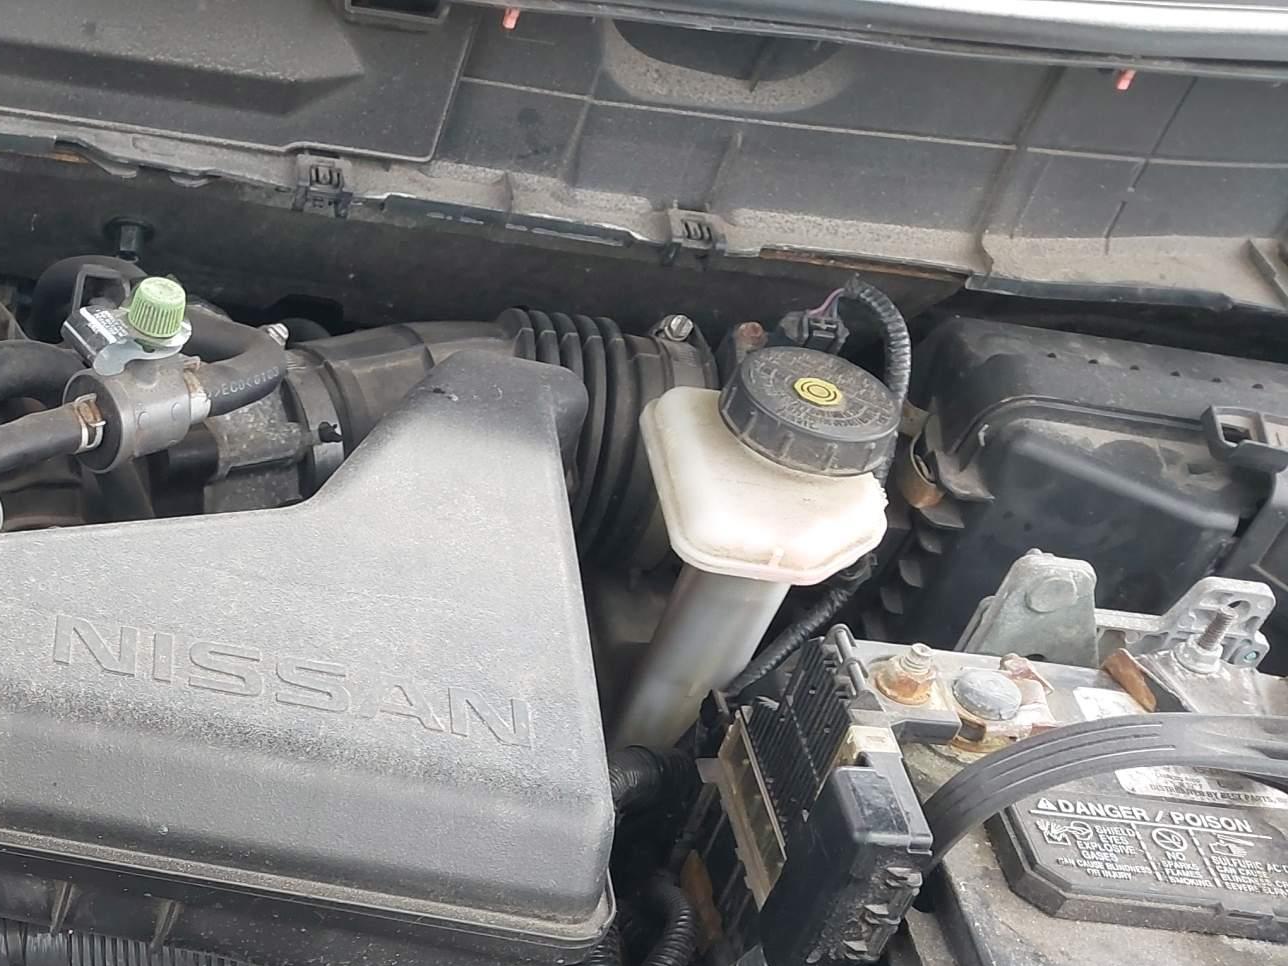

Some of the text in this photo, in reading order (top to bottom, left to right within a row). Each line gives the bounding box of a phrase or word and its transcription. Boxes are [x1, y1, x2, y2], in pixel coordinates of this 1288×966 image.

[53, 614, 534, 749] NISSAN
[1207, 790, 1218, 800] BY
[1057, 799, 1253, 832] DANGER / POISON
[1094, 825, 1135, 837] SHIELD
[1098, 835, 1129, 845] EYES
[1076, 841, 1137, 855] EXPLOSIVE
[1081, 850, 1119, 862] GASES
[1166, 851, 1186, 861] NO
[1078, 860, 1104, 870] CAUSE
[1105, 862, 1152, 874] BLINDNESS
[1162, 860, 1199, 871] SPARKS
[1211, 856, 1264, 871] SULFURIC
[1102, 870, 1132, 880] INJURY
[1165, 869, 1202, 879] FLAMES
[1216, 865, 1270, 879] CAN CAUSE
[1169, 877, 1213, 888] SMOKING
[1225, 882, 1261, 894] SEVERE
